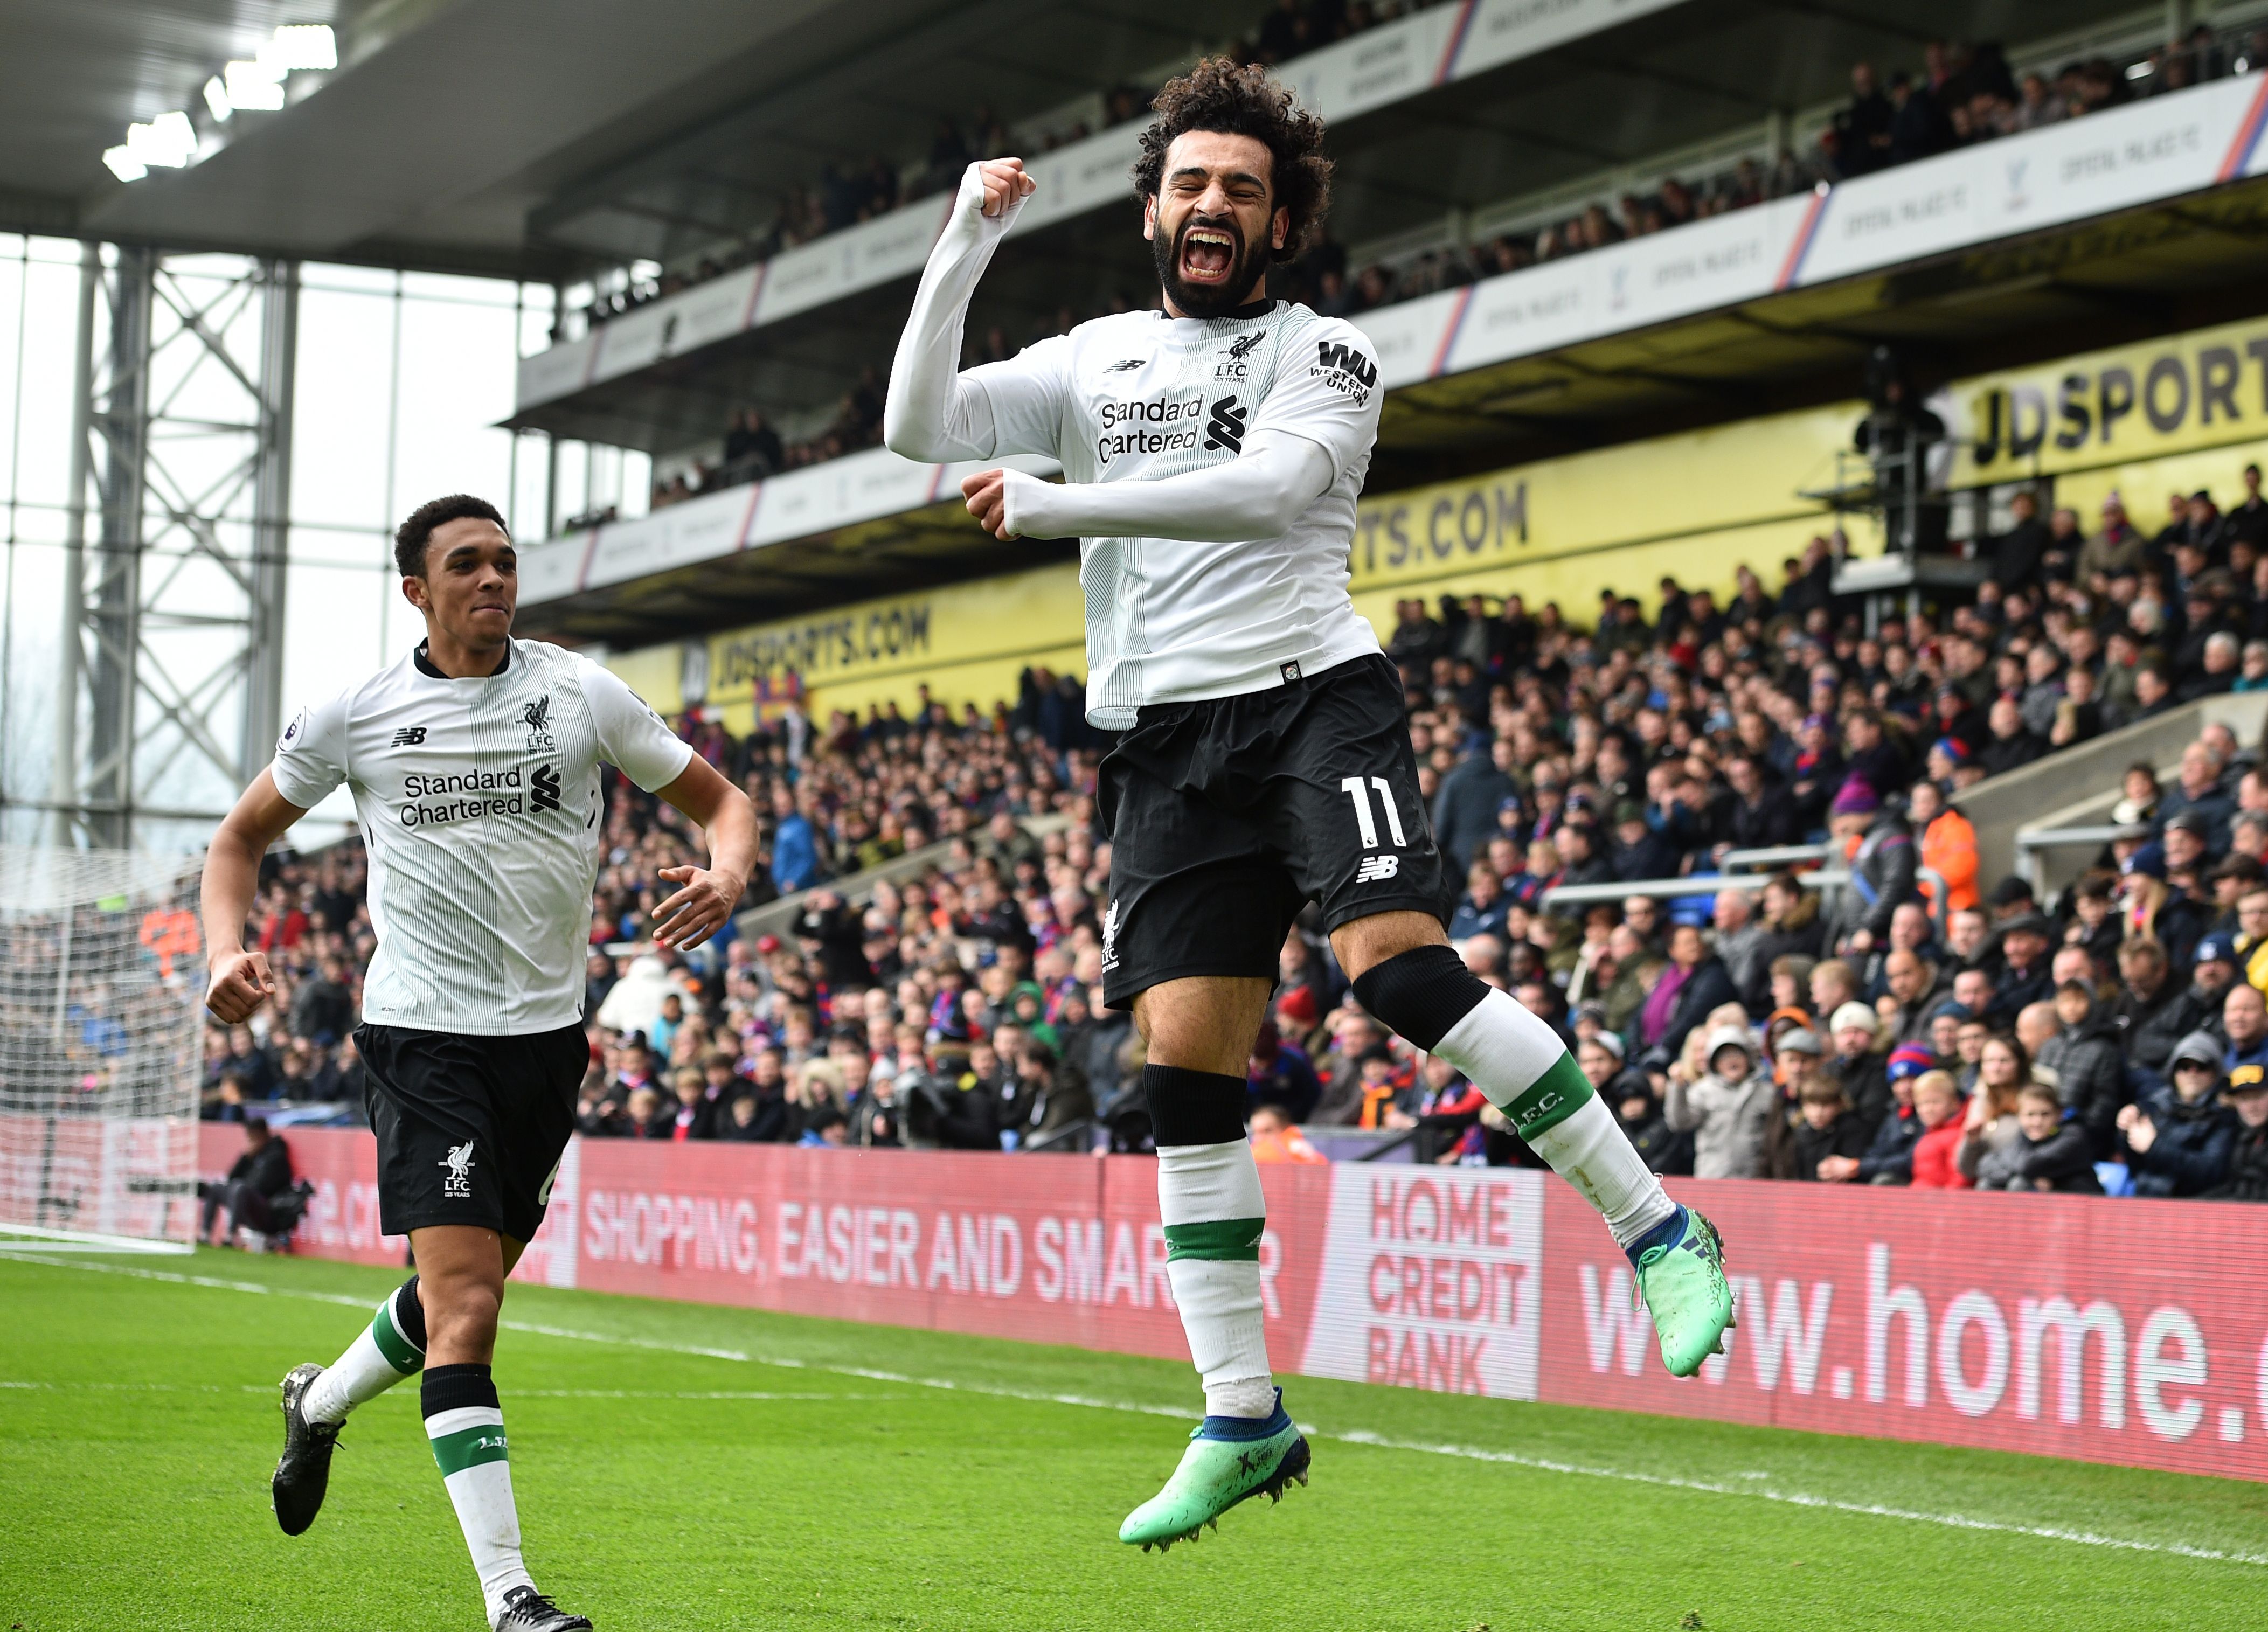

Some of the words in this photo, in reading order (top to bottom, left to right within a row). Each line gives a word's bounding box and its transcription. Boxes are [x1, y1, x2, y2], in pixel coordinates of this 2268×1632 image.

[1310, 367, 1369, 401] WESTERN
[1318, 341, 1377, 388] WU
[1101, 394, 1204, 429] Sandard
[1327, 377, 1364, 408] UNION
[1099, 425, 1198, 464] Cartered
[405, 766, 522, 798] Standard
[401, 793, 523, 827] Chartered
[1342, 776, 1407, 849] 11
[1371, 1176, 1512, 1247] HOME
[585, 1189, 767, 1288] SHOPPING,
[778, 1200, 921, 1290] EASIER
[926, 1210, 1023, 1298] AND
[1032, 1216, 1282, 1319] SMARR
[1369, 1251, 1527, 1327] CREDIT
[1367, 1322, 1487, 1396] BANK
